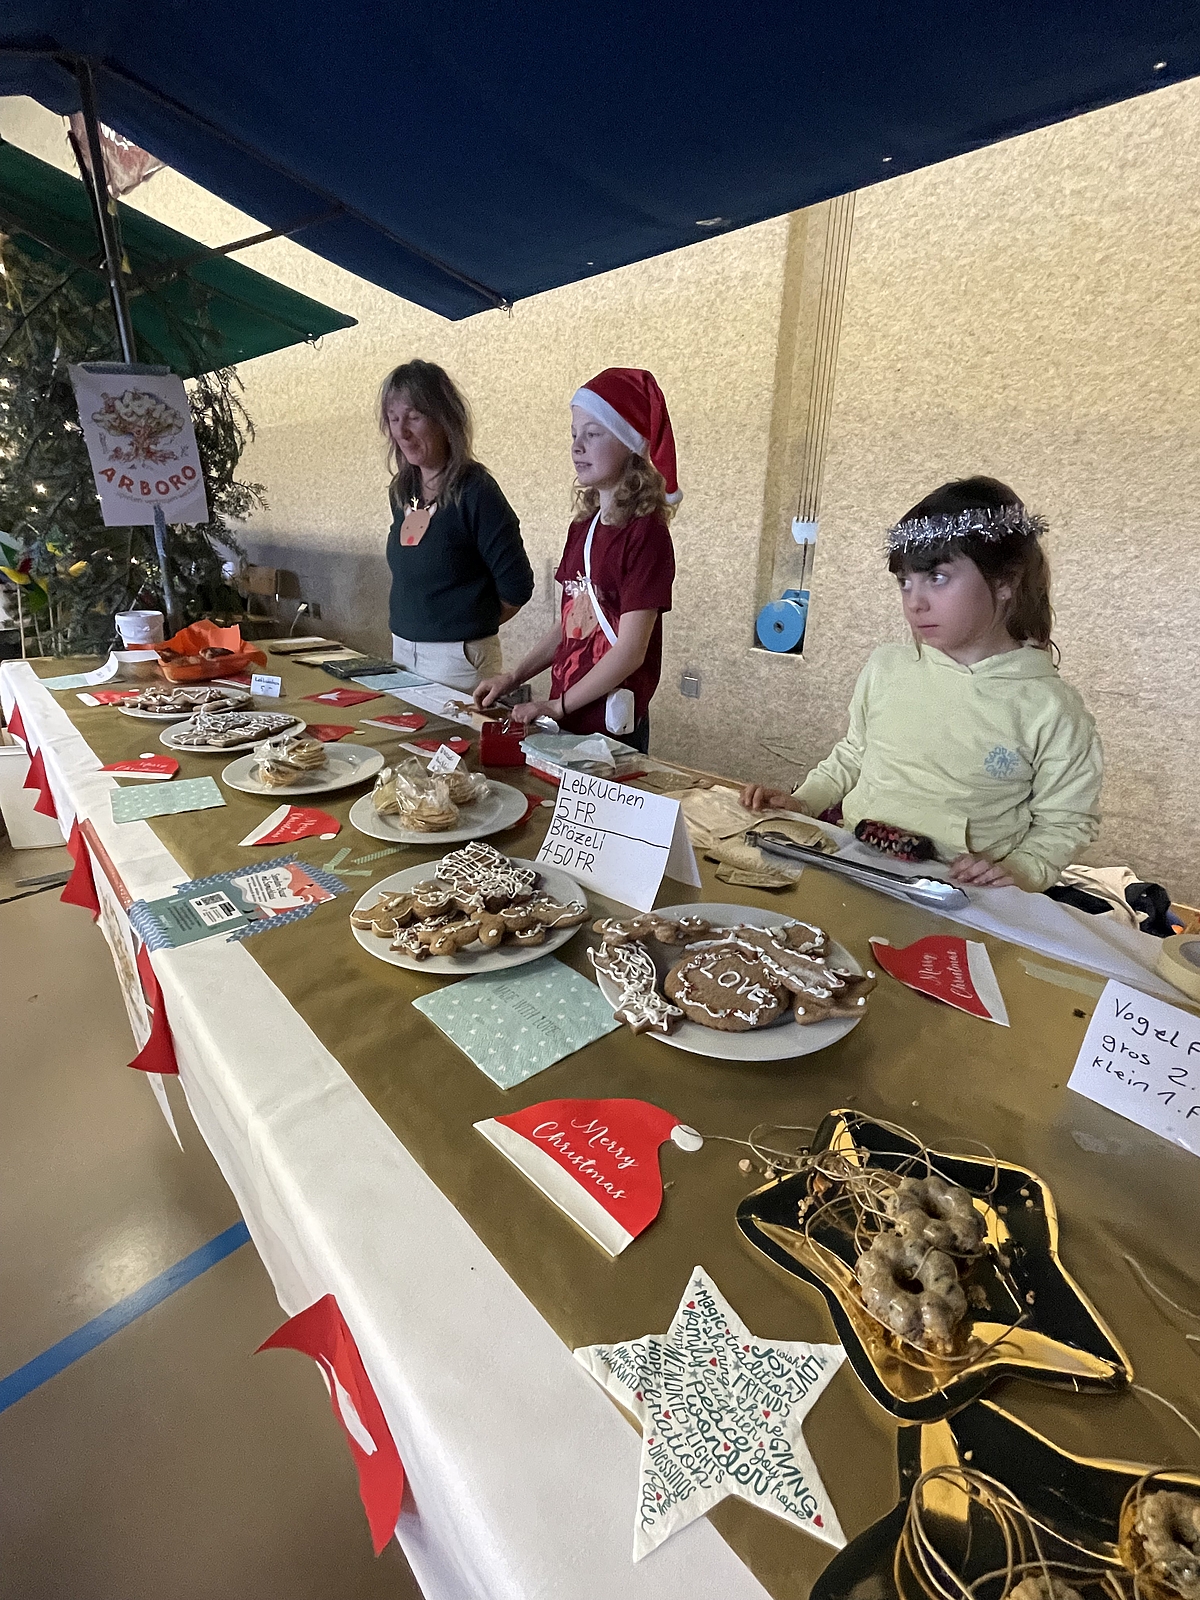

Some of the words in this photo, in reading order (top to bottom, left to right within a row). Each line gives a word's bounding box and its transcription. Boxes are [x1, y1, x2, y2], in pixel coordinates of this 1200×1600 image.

[98, 465, 196, 496] ARBORO
[557, 797, 571, 819] 5
[574, 800, 597, 824] FR
[574, 850, 595, 873] FR
[700, 961, 772, 1005] LOVE
[919, 952, 943, 985] Merry
[946, 949, 973, 999] Christmas
[512, 1000, 541, 1021] WITH
[532, 1121, 627, 1200] Christmas
[570, 1117, 639, 1170] Merry
[694, 1289, 727, 1330] Magic
[648, 1339, 664, 1380] HOPE
[682, 1309, 714, 1368] family
[702, 1326, 731, 1390] sharing
[775, 1348, 802, 1369] wish
[600, 1352, 641, 1392] WARMTH
[662, 1343, 690, 1424] MEMORIES
[725, 1333, 806, 1403] tradition
[785, 1354, 824, 1396] LOVE
[686, 1380, 753, 1453] peace
[702, 1368, 761, 1443] laughter
[731, 1372, 792, 1418] FRIENDS
[736, 1395, 784, 1437] shine
[685, 1431, 726, 1484] LIGHTS
[686, 1394, 769, 1496] wonder
[647, 1442, 697, 1501] blessings
[769, 1437, 818, 1519] GIVING
[770, 1480, 807, 1520] hope
